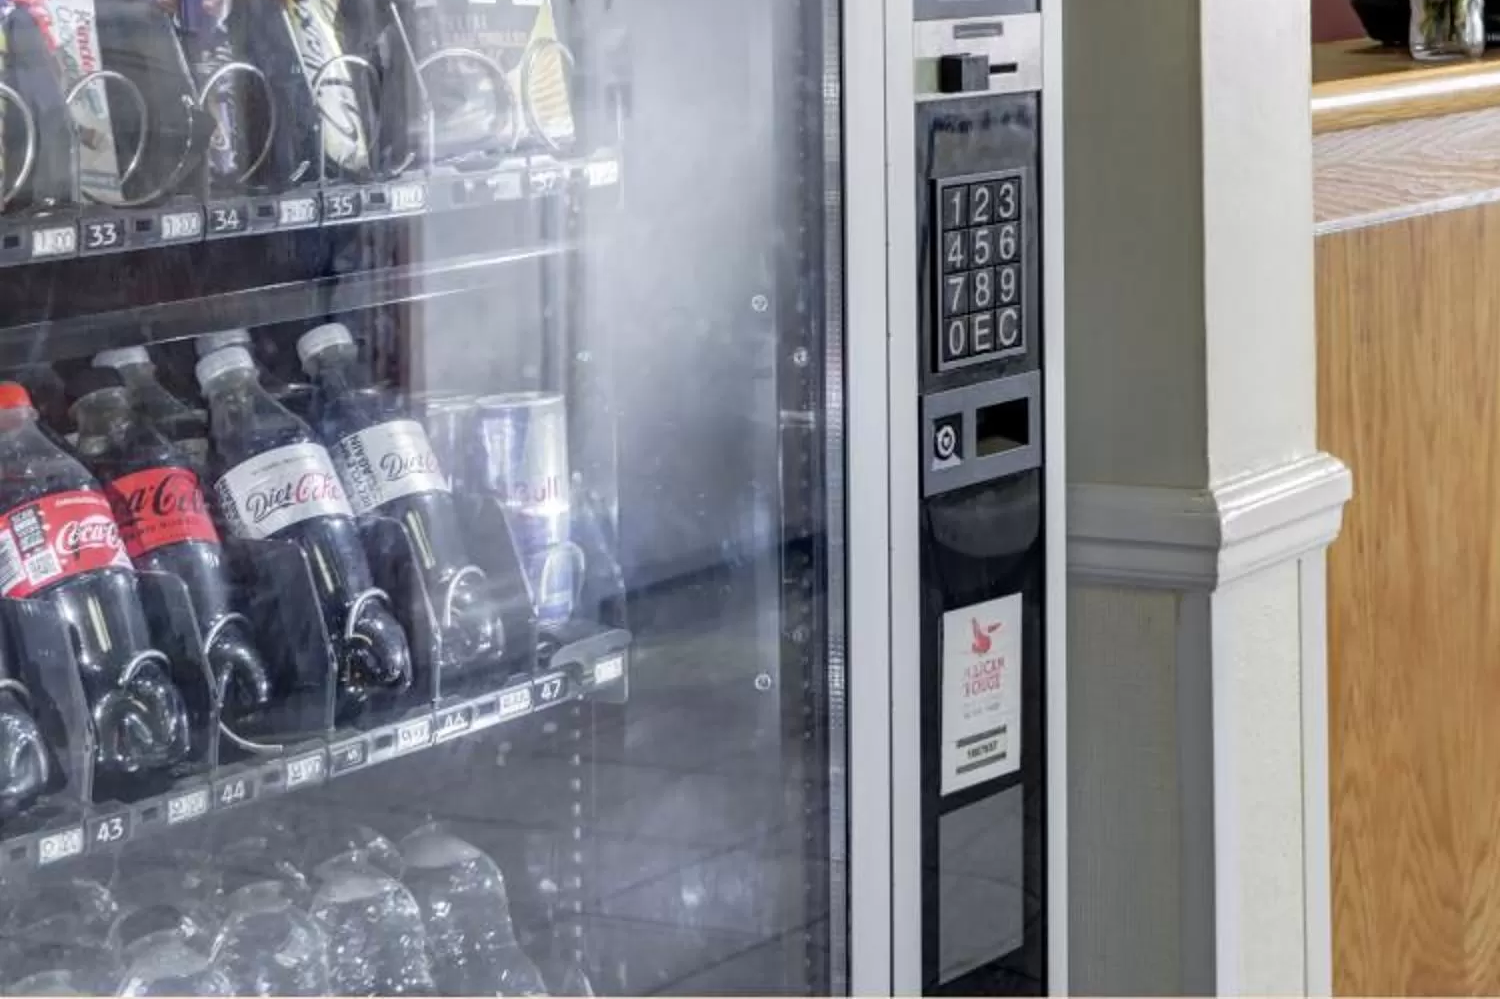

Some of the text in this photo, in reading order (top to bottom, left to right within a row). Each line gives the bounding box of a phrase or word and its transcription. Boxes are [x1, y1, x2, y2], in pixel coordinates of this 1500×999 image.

[73, 8, 98, 77] Kinde
[213, 209, 240, 231] 34
[329, 196, 353, 217] 35
[951, 182, 1015, 226] 1 2 3
[87, 222, 118, 248] 33
[948, 224, 1015, 268] 4 5 6
[948, 267, 1015, 312] 7 8 9
[949, 308, 1018, 356] 0 E C
[245, 481, 297, 524] Diet
[295, 471, 342, 504] Coke
[541, 679, 562, 701] 47
[221, 779, 246, 804] 44
[96, 816, 124, 842] 43
